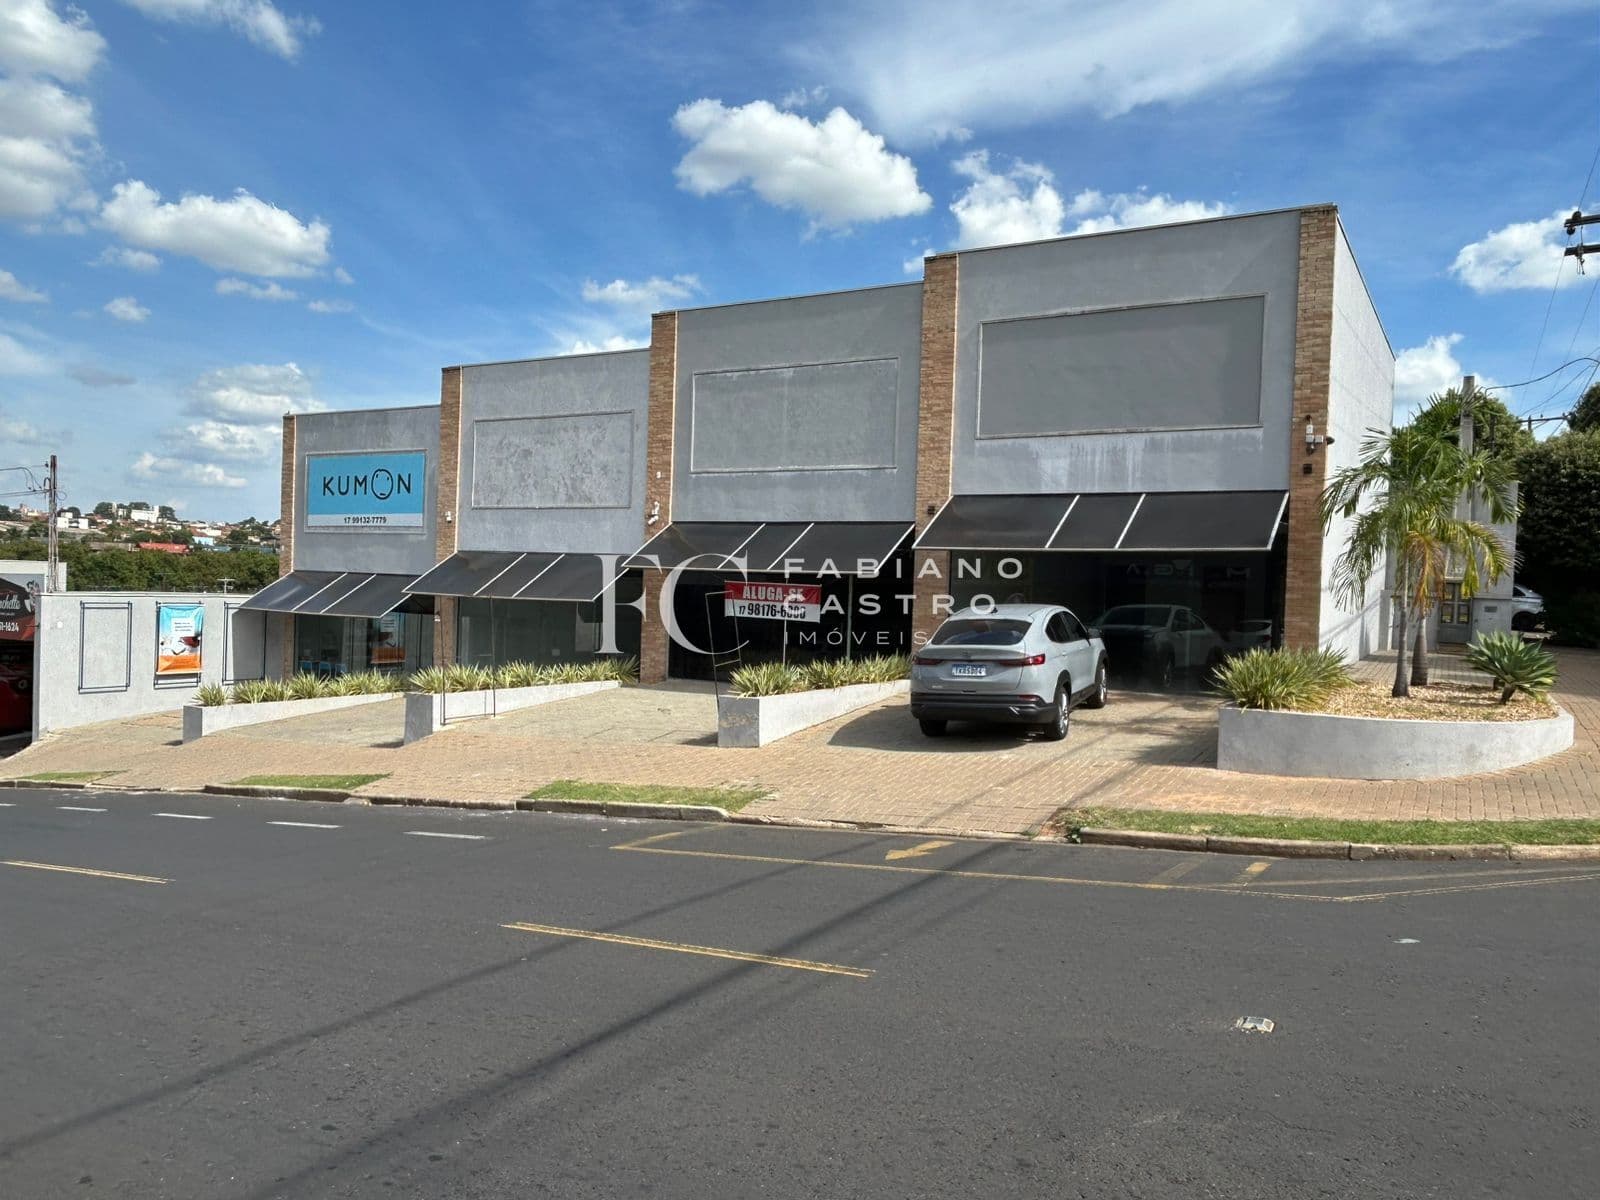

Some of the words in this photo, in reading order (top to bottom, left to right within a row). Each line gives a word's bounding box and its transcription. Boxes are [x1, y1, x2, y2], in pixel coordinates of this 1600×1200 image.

[322, 468, 412, 500] KUMON
[343, 517, 351, 525] 17
[352, 516, 388, 525] 99132-7779
[741, 585, 806, 603] ALUGA-SE
[738, 605, 746, 615] 17
